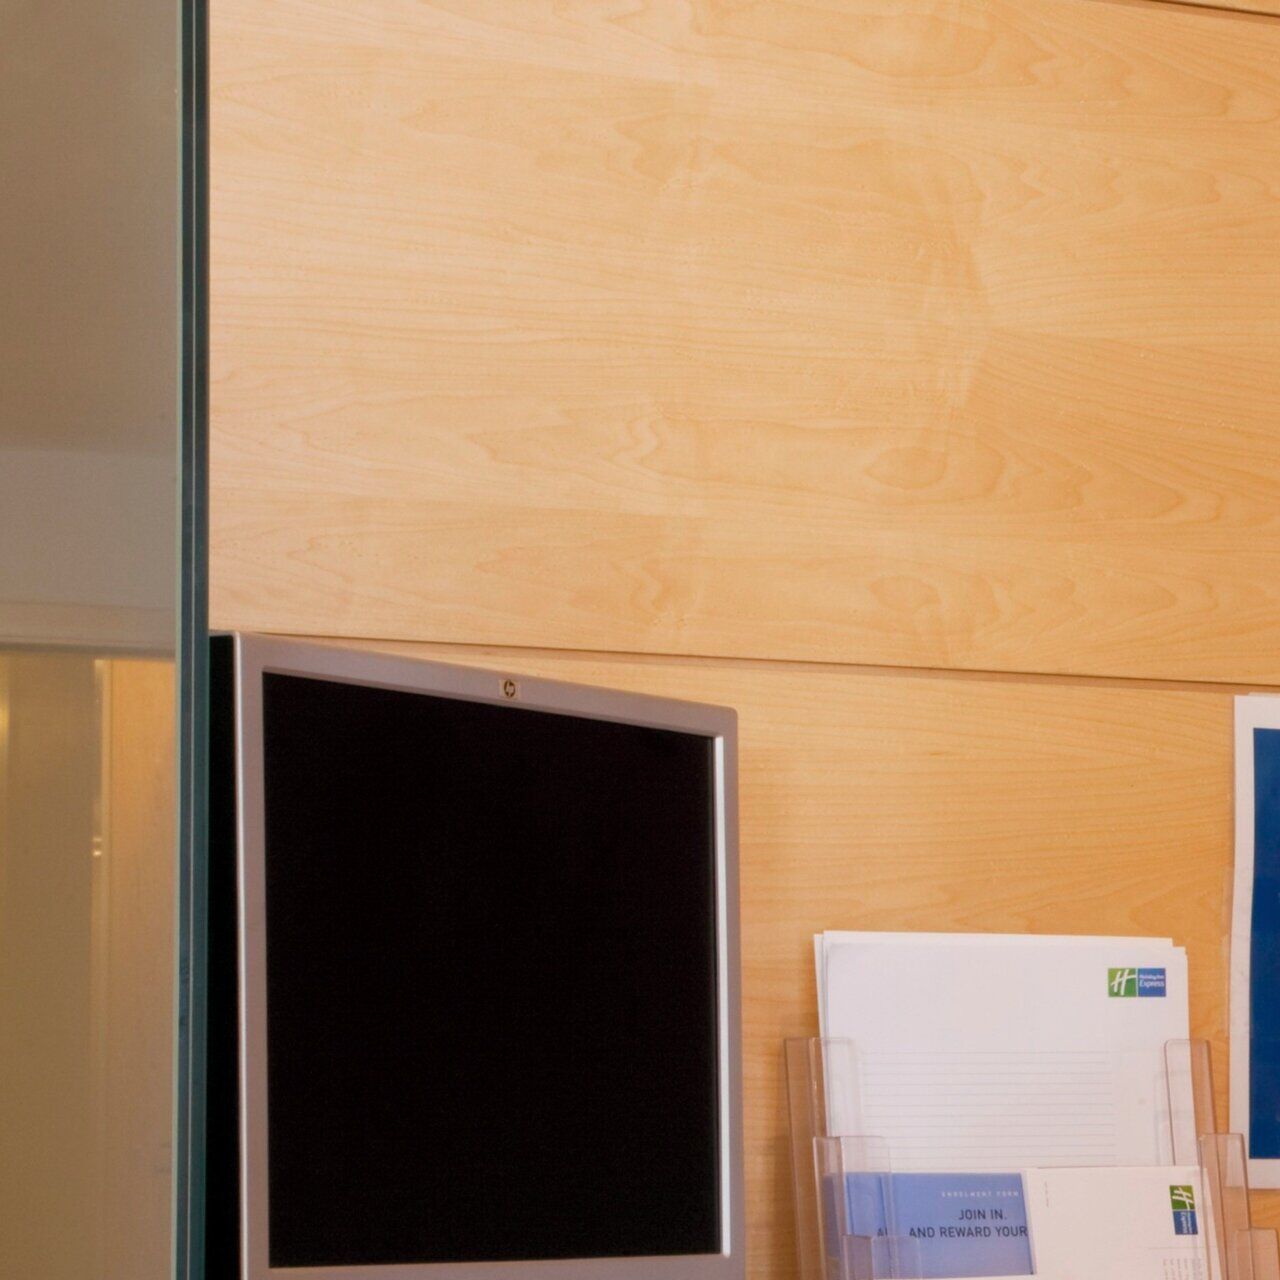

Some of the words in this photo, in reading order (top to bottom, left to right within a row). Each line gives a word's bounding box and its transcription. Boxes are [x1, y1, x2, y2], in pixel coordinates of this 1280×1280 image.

[958, 1209, 986, 1221] JOIN
[990, 1209, 1008, 1220] IN.
[909, 1227, 935, 1238] AND
[940, 1226, 991, 1238] REWARD
[995, 1226, 1028, 1237] YOUR
